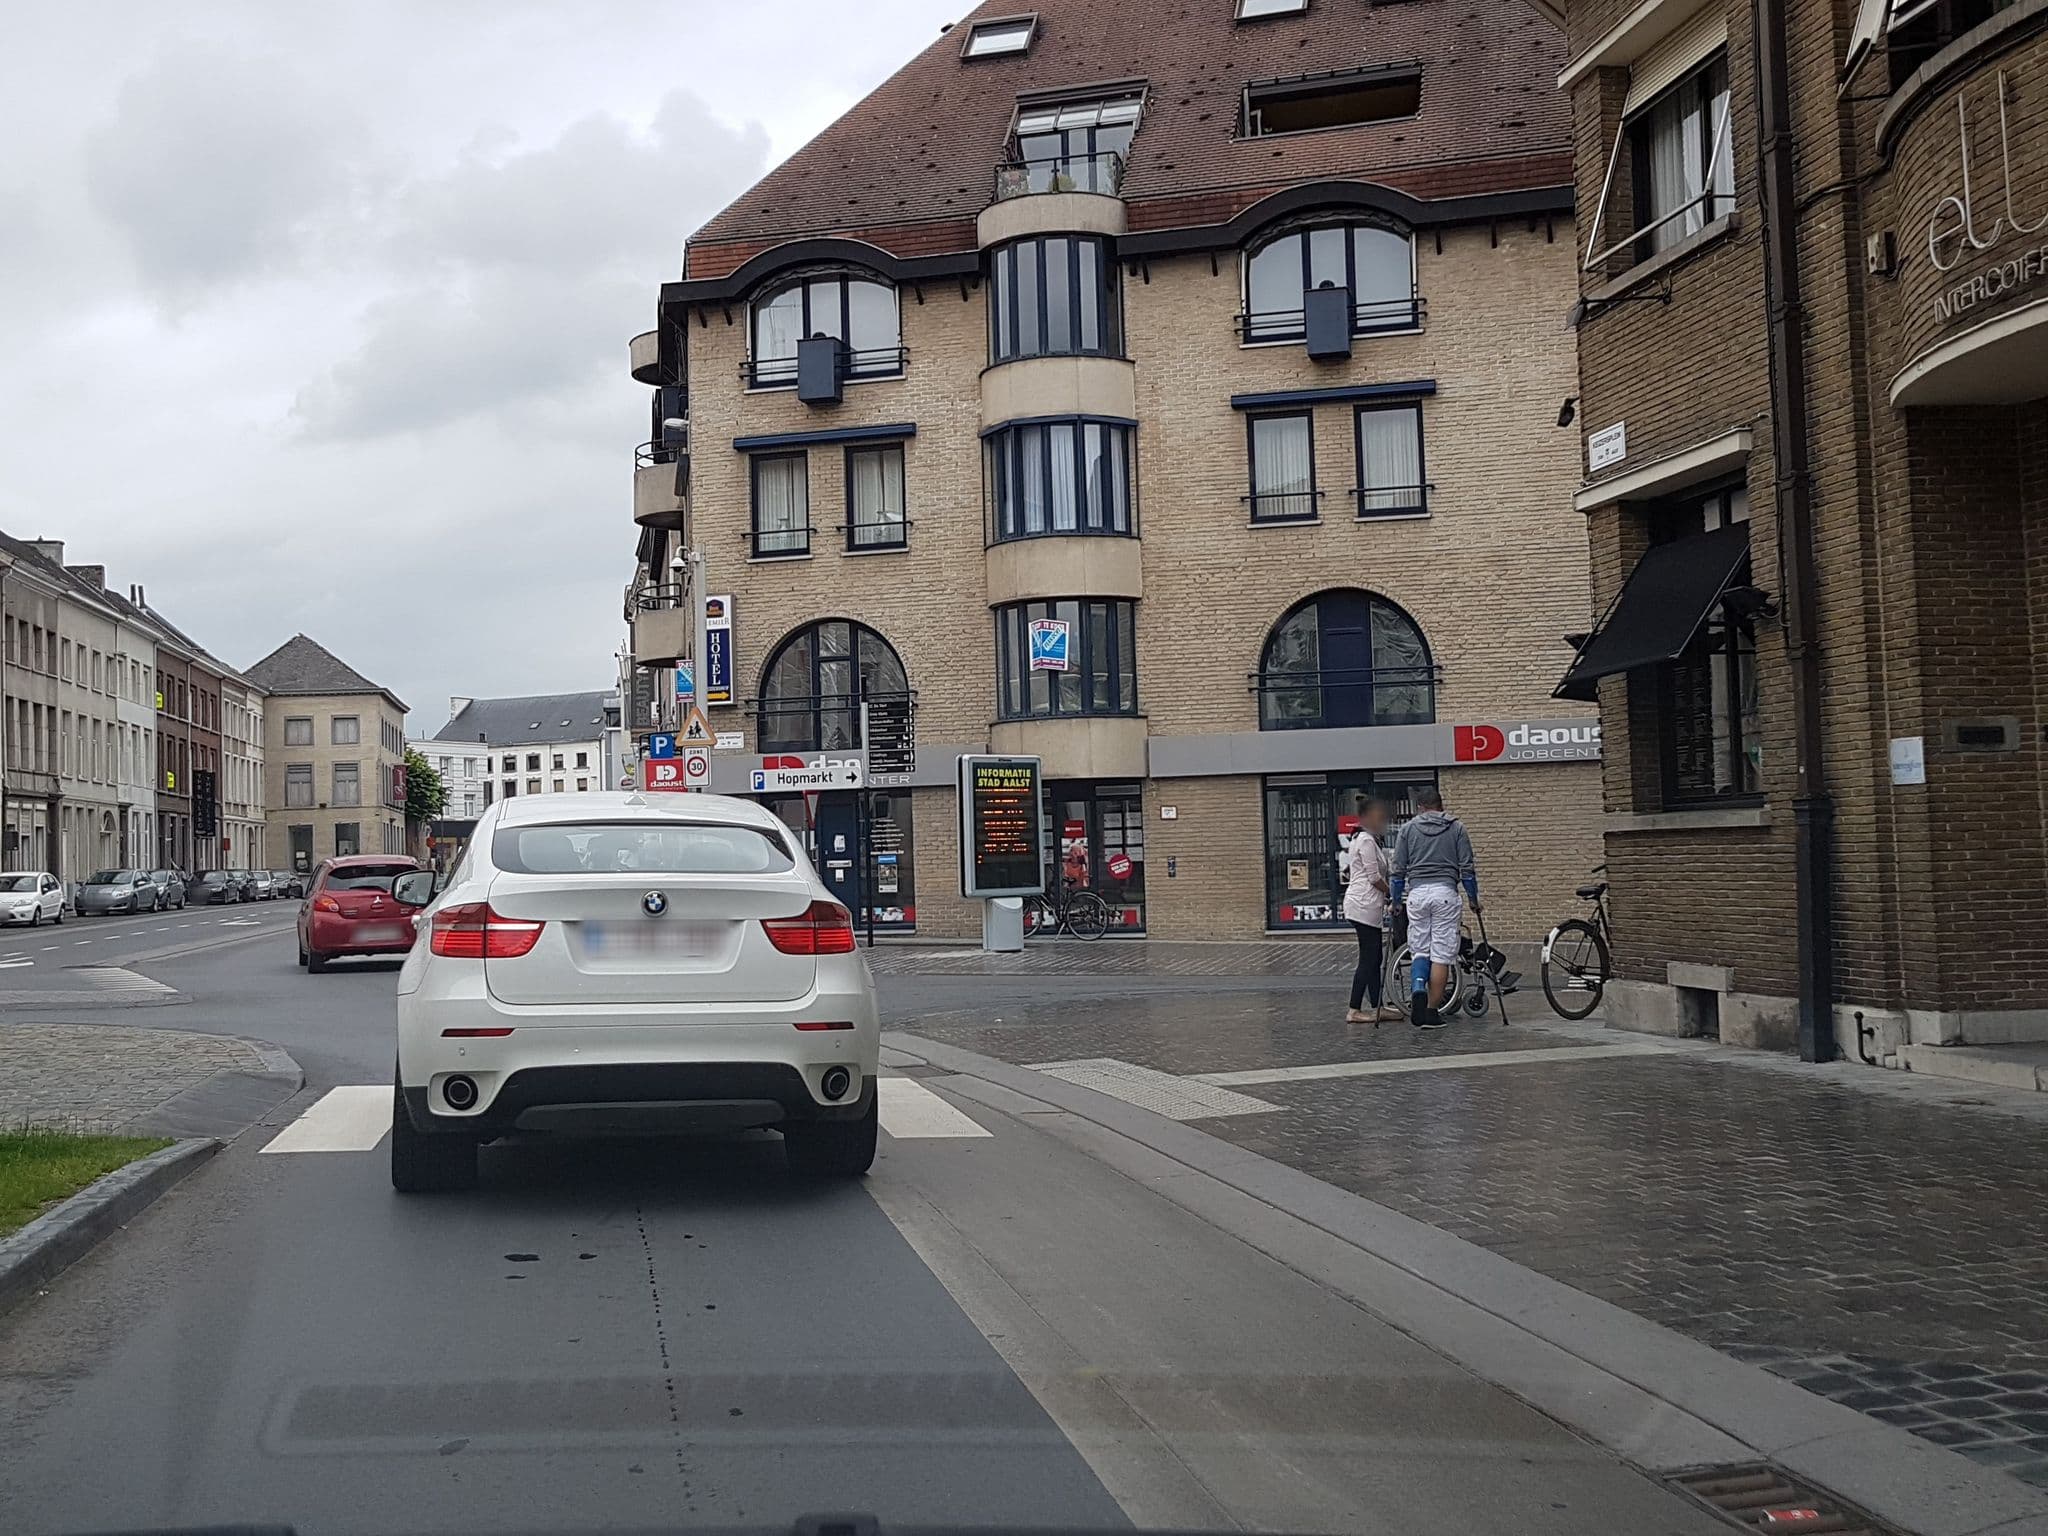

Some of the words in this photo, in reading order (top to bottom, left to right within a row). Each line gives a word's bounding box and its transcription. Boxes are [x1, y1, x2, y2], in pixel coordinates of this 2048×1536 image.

[711, 633, 721, 686] HOTEL
[655, 737, 667, 755] P
[691, 762, 703, 771] 30
[977, 768, 1031, 777] INFORMATIE
[777, 772, 833, 787] Hopmarkt
[978, 778, 1000, 787] STAD
[1002, 778, 1030, 787] AALST
